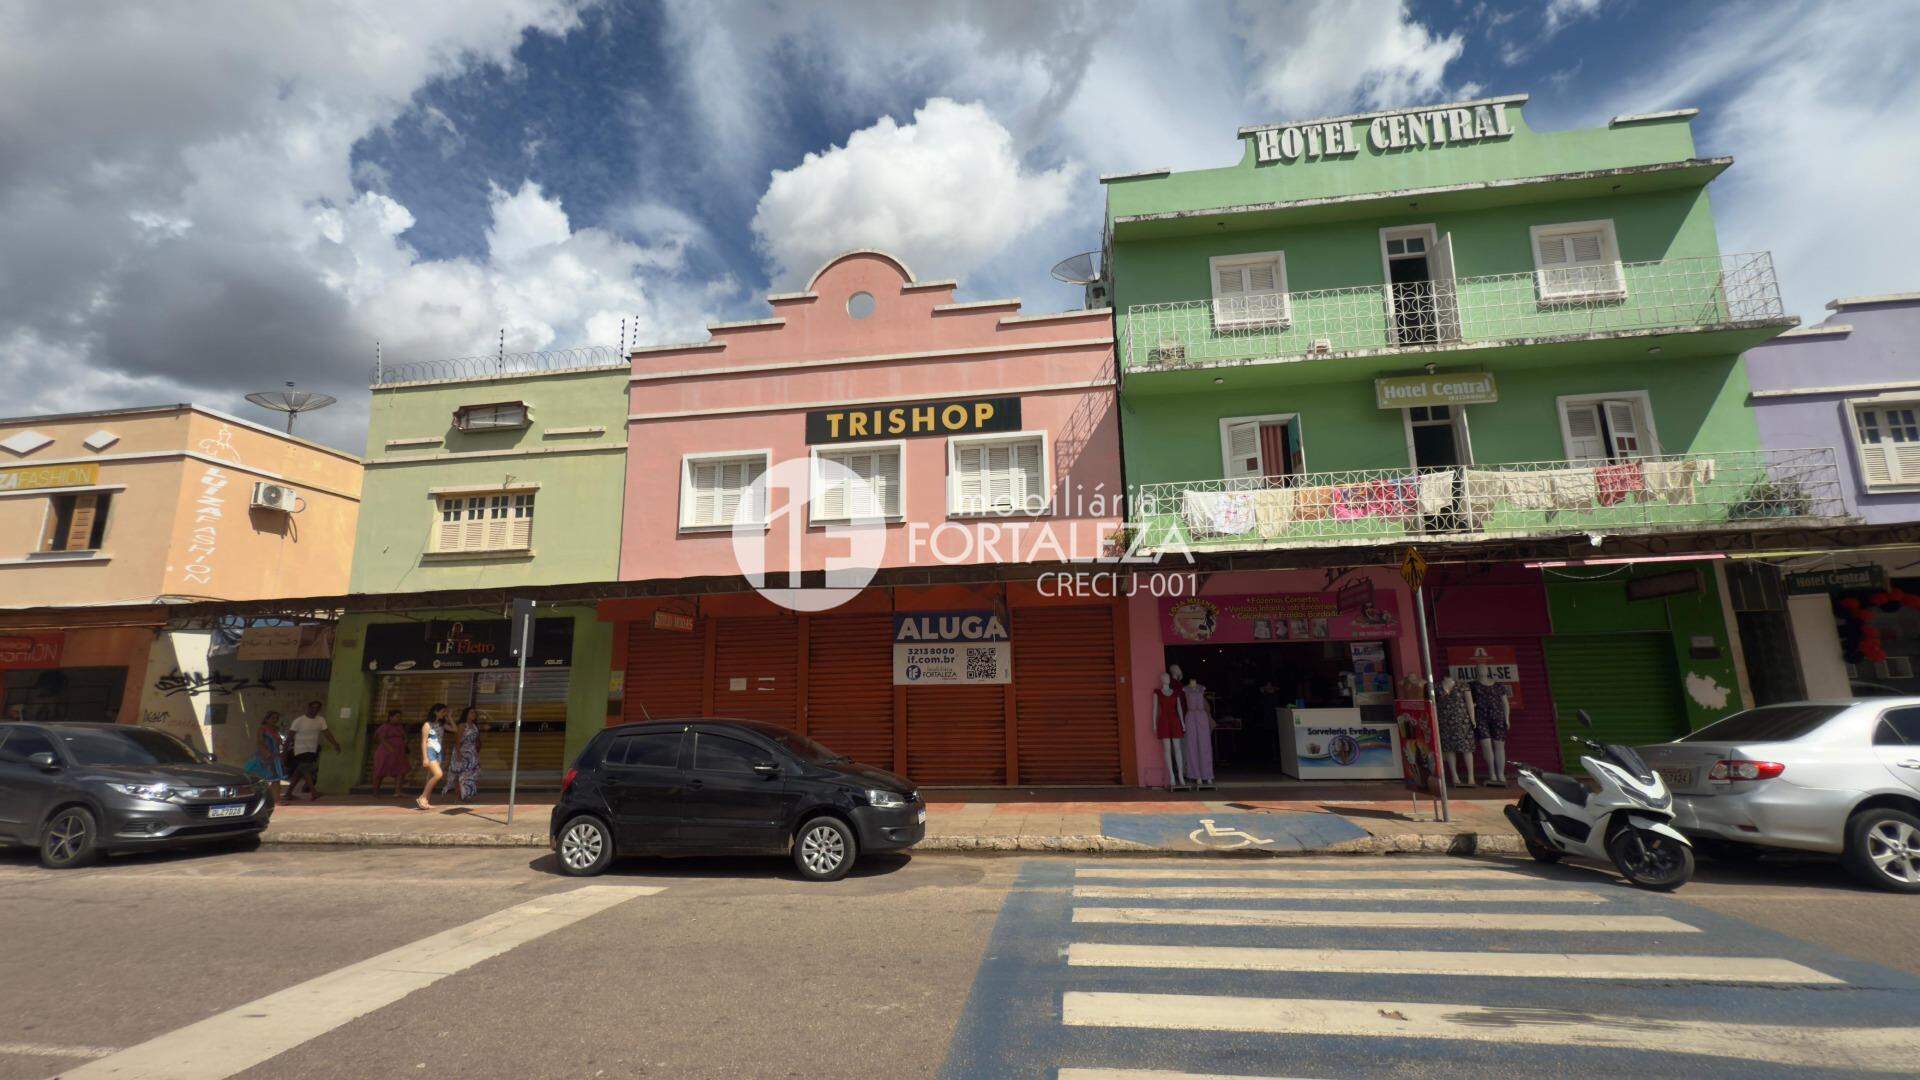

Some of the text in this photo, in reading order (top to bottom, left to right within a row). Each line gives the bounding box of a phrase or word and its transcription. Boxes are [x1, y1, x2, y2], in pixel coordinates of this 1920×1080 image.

[1255, 103, 1515, 163] HOTEL CENTRAL
[1384, 379, 1491, 399] Hotel Central
[826, 403, 994, 438] TRISHOP
[1796, 574, 1826, 588] Hotel
[1829, 570, 1871, 585] Central
[897, 615, 1008, 640] ALUGA
[907, 654, 955, 664] if.com.br
